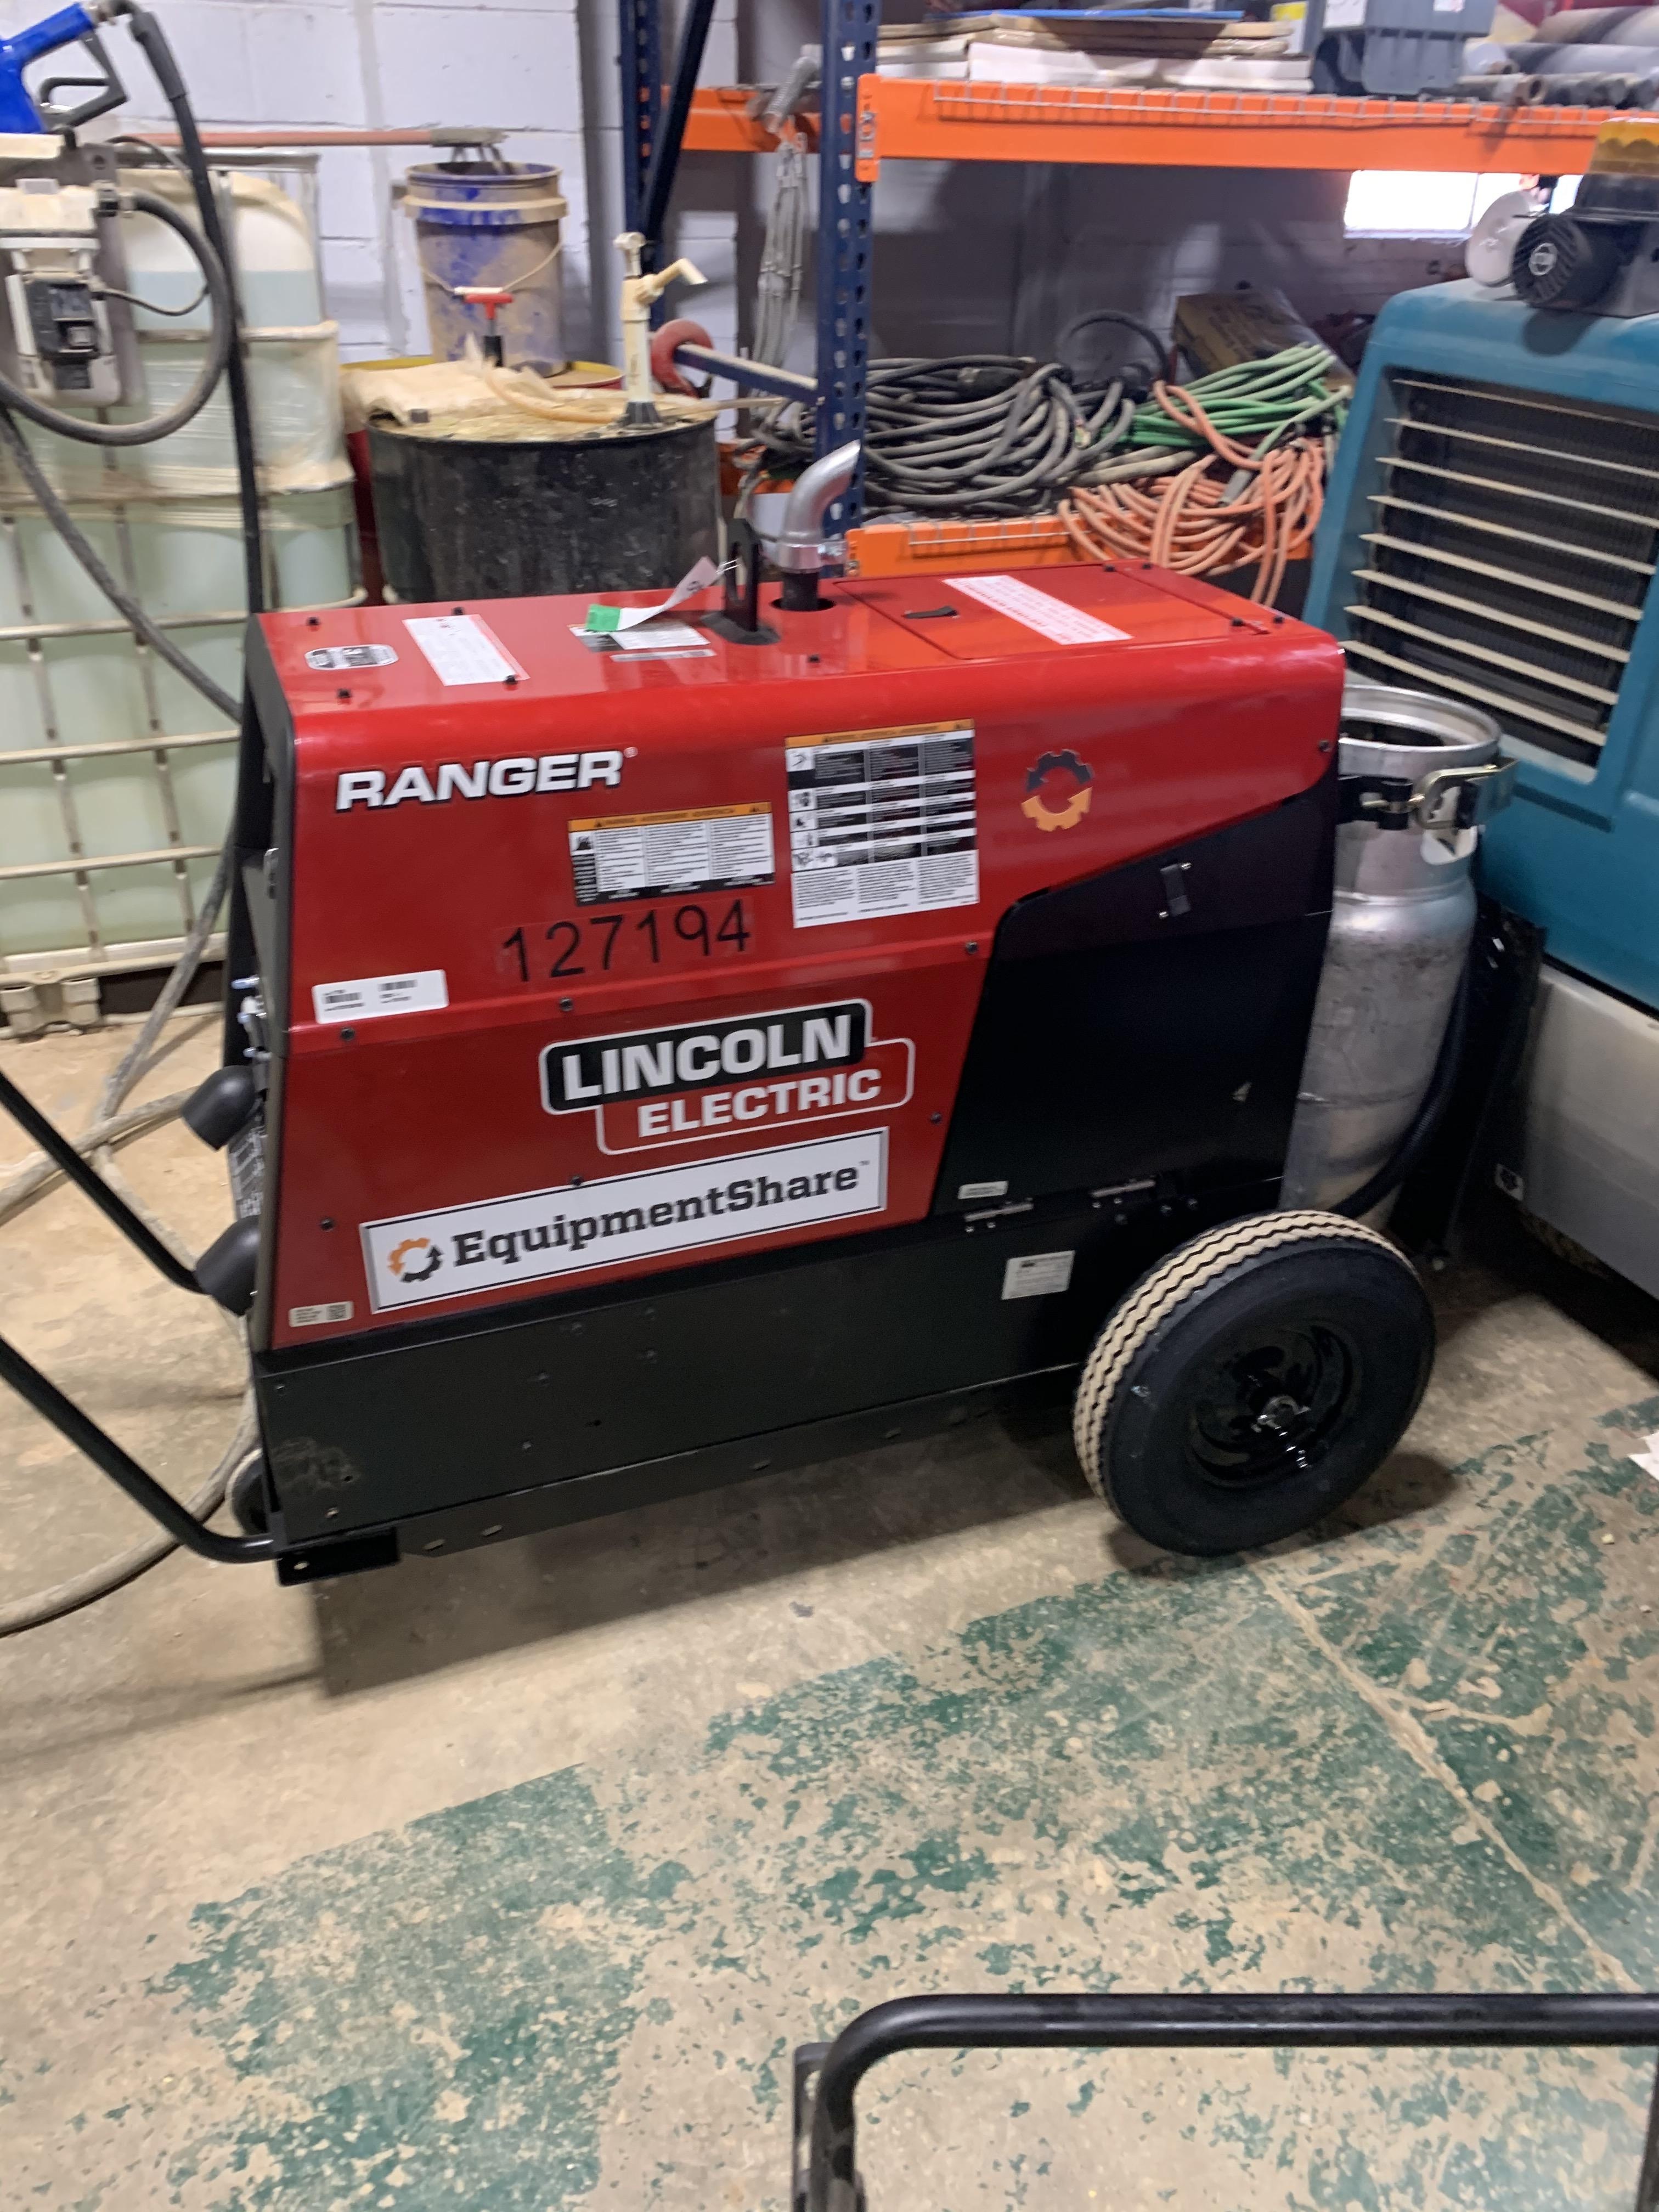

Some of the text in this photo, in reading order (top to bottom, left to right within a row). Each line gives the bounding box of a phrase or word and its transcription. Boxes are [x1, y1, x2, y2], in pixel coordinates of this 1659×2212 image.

[335, 751, 623, 812] RANGER
[501, 900, 751, 983] 127194
[562, 1015, 851, 1101] LINCOLN
[638, 1069, 881, 1137] ELECTRIC
